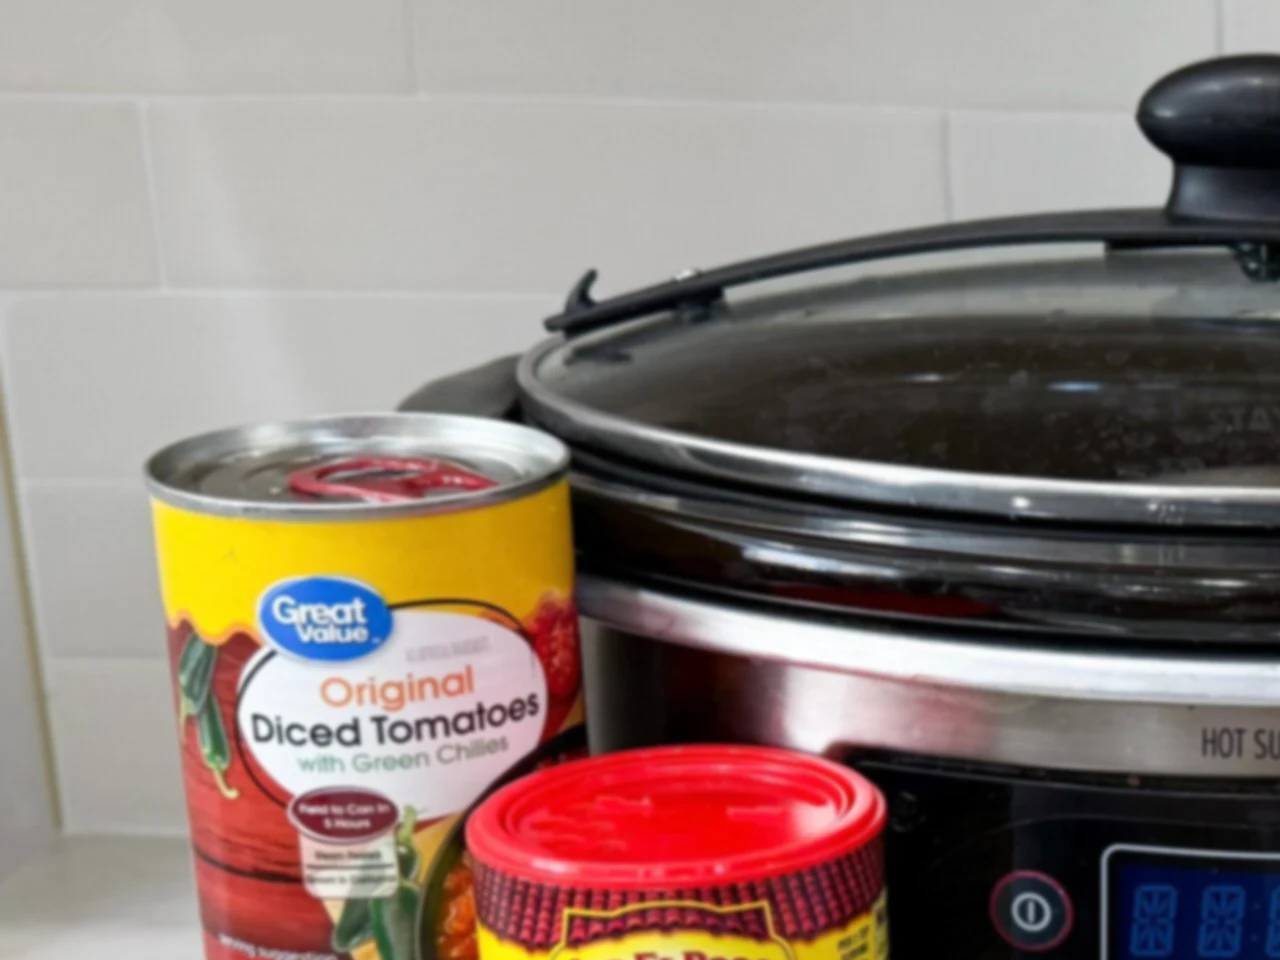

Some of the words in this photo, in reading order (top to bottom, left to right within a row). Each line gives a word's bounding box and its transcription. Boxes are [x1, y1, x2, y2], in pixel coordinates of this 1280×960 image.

[271, 596, 367, 627] Great
[298, 620, 369, 645] Value
[319, 664, 475, 711] Original
[251, 712, 361, 747] Diced
[369, 690, 540, 745] Tomatoes
[1201, 727, 1246, 759] HOT
[297, 753, 346, 774] with
[352, 750, 430, 774] Green
